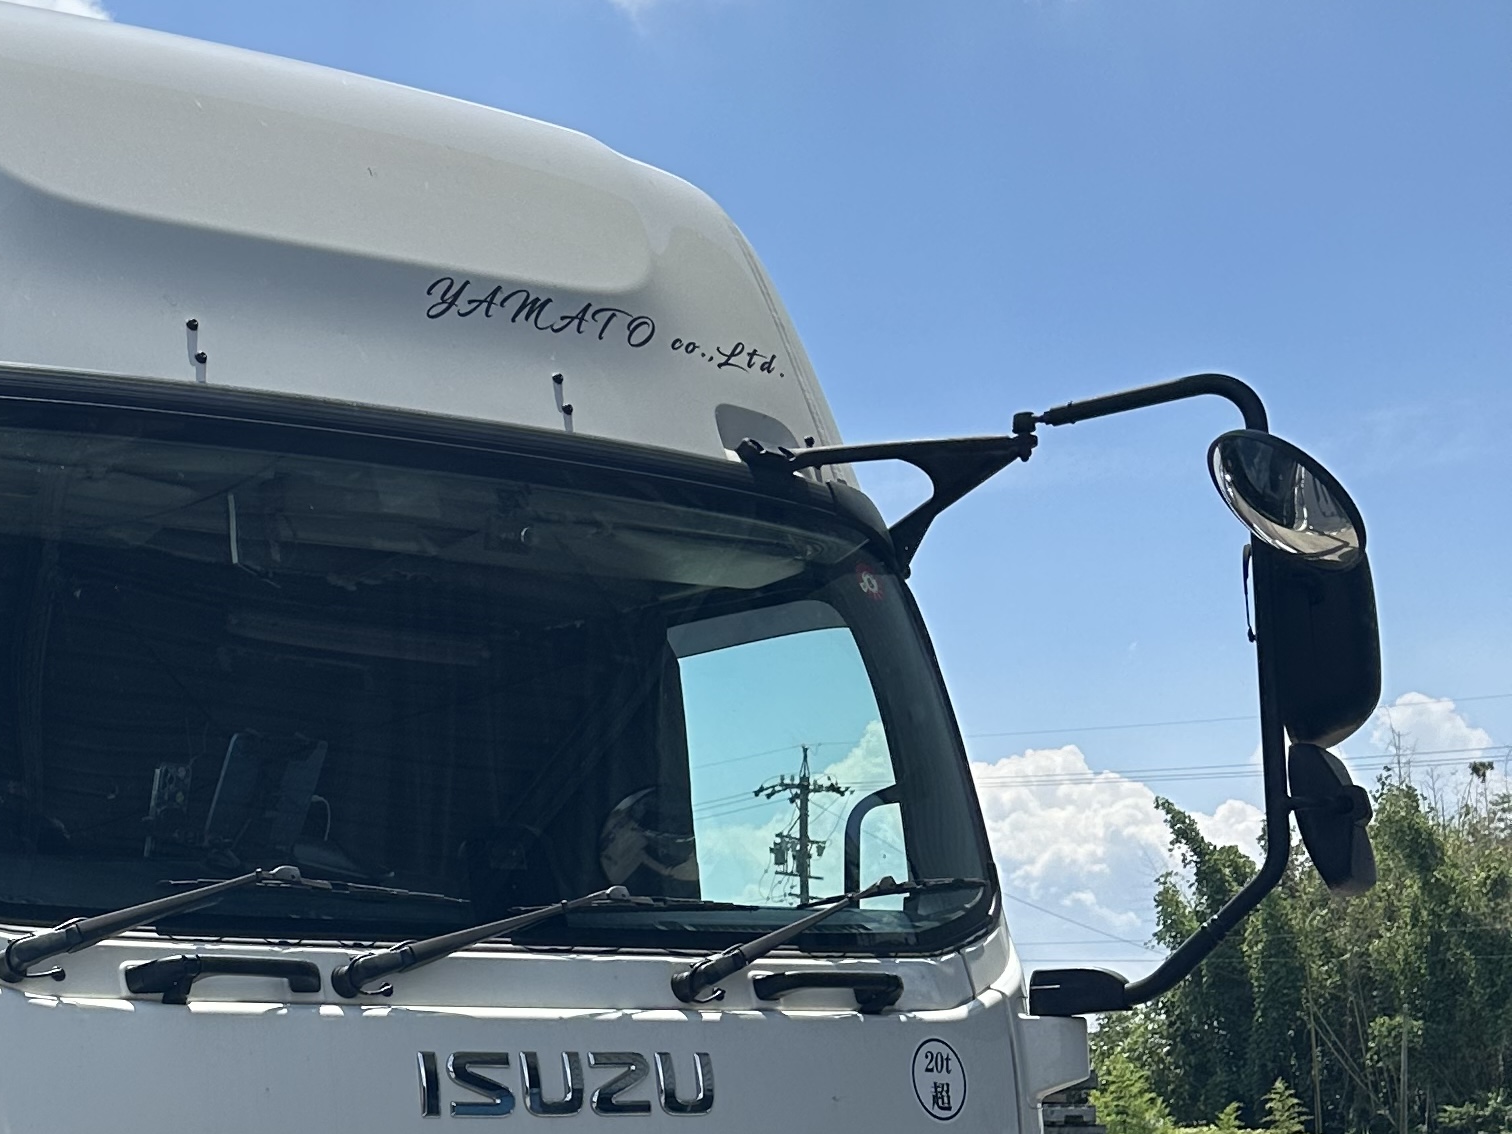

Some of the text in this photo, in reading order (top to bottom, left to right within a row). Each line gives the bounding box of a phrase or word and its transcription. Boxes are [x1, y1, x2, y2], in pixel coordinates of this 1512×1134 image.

[426, 276, 656, 348] YAMATO
[416, 1050, 715, 1119] ISUZU
[924, 1050, 952, 1075] 20t
[930, 1081, 953, 1112] 超
